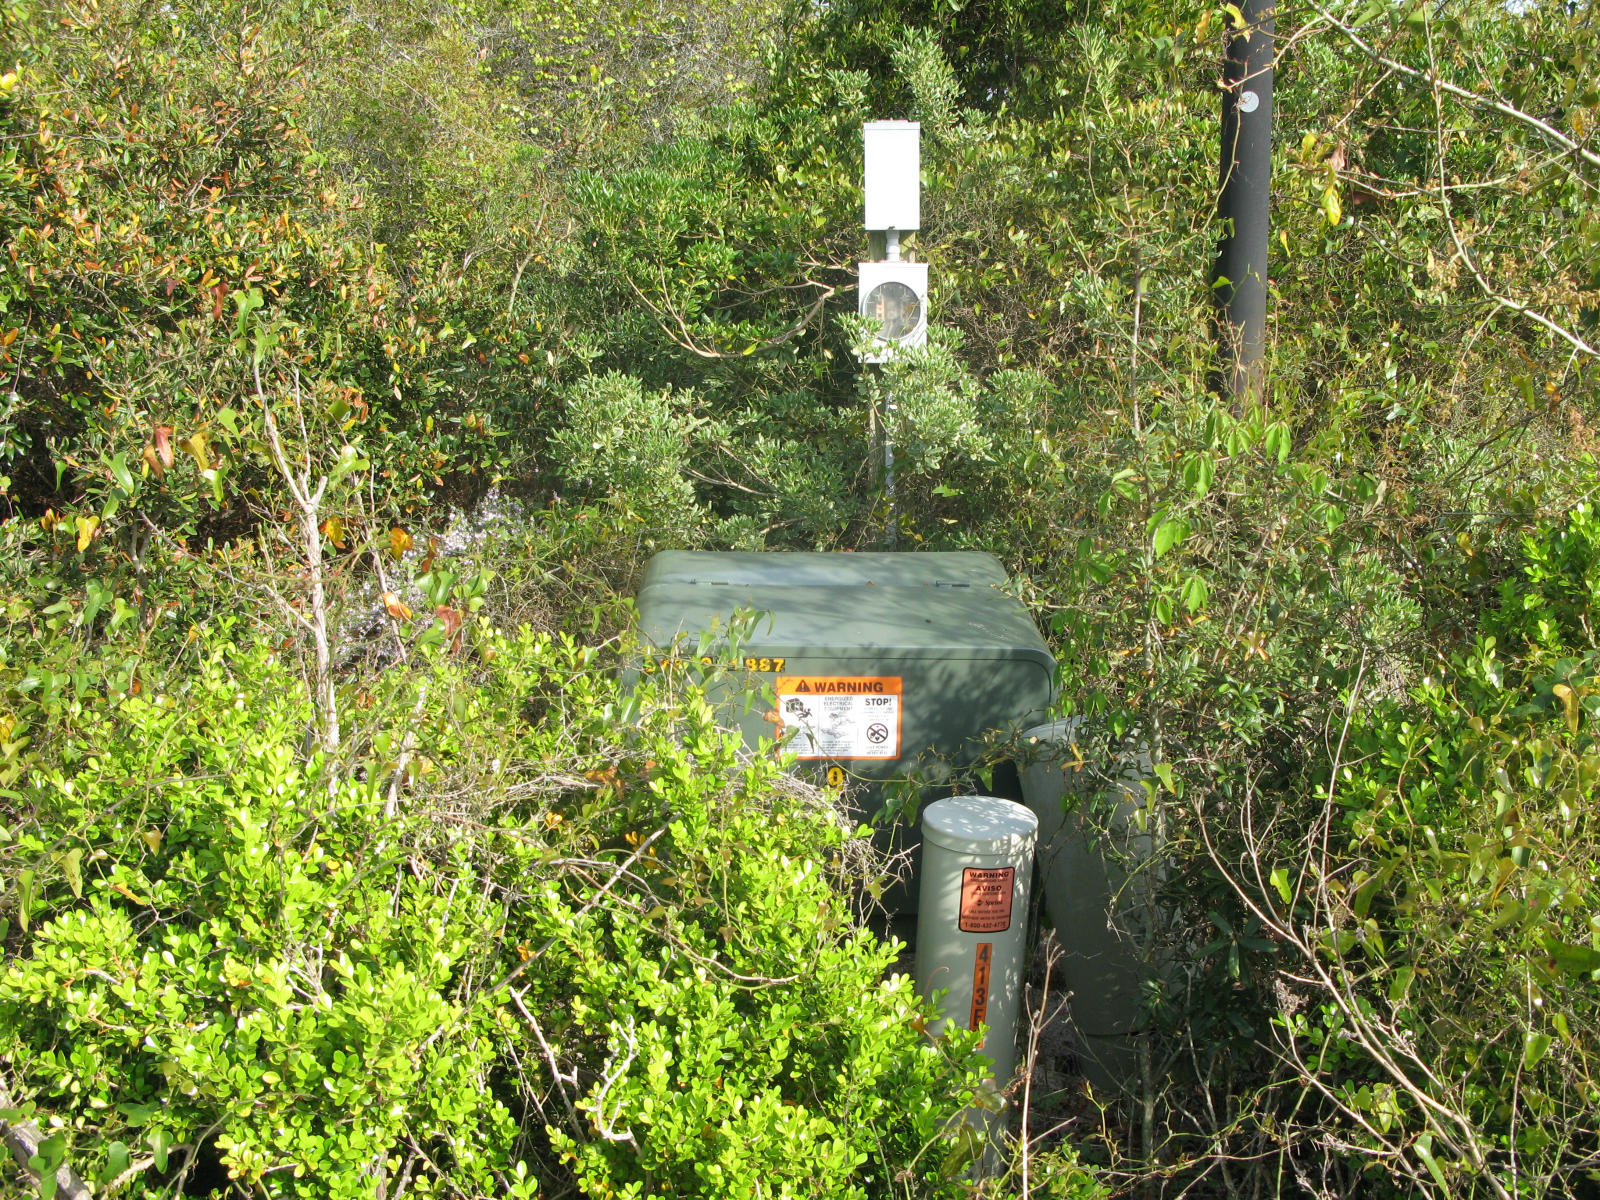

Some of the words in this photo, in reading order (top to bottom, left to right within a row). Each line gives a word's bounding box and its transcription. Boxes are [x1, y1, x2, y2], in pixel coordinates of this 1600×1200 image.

[814, 681, 884, 693] WARNING
[865, 697, 892, 706] STOP!
[969, 871, 1009, 879] WARNING
